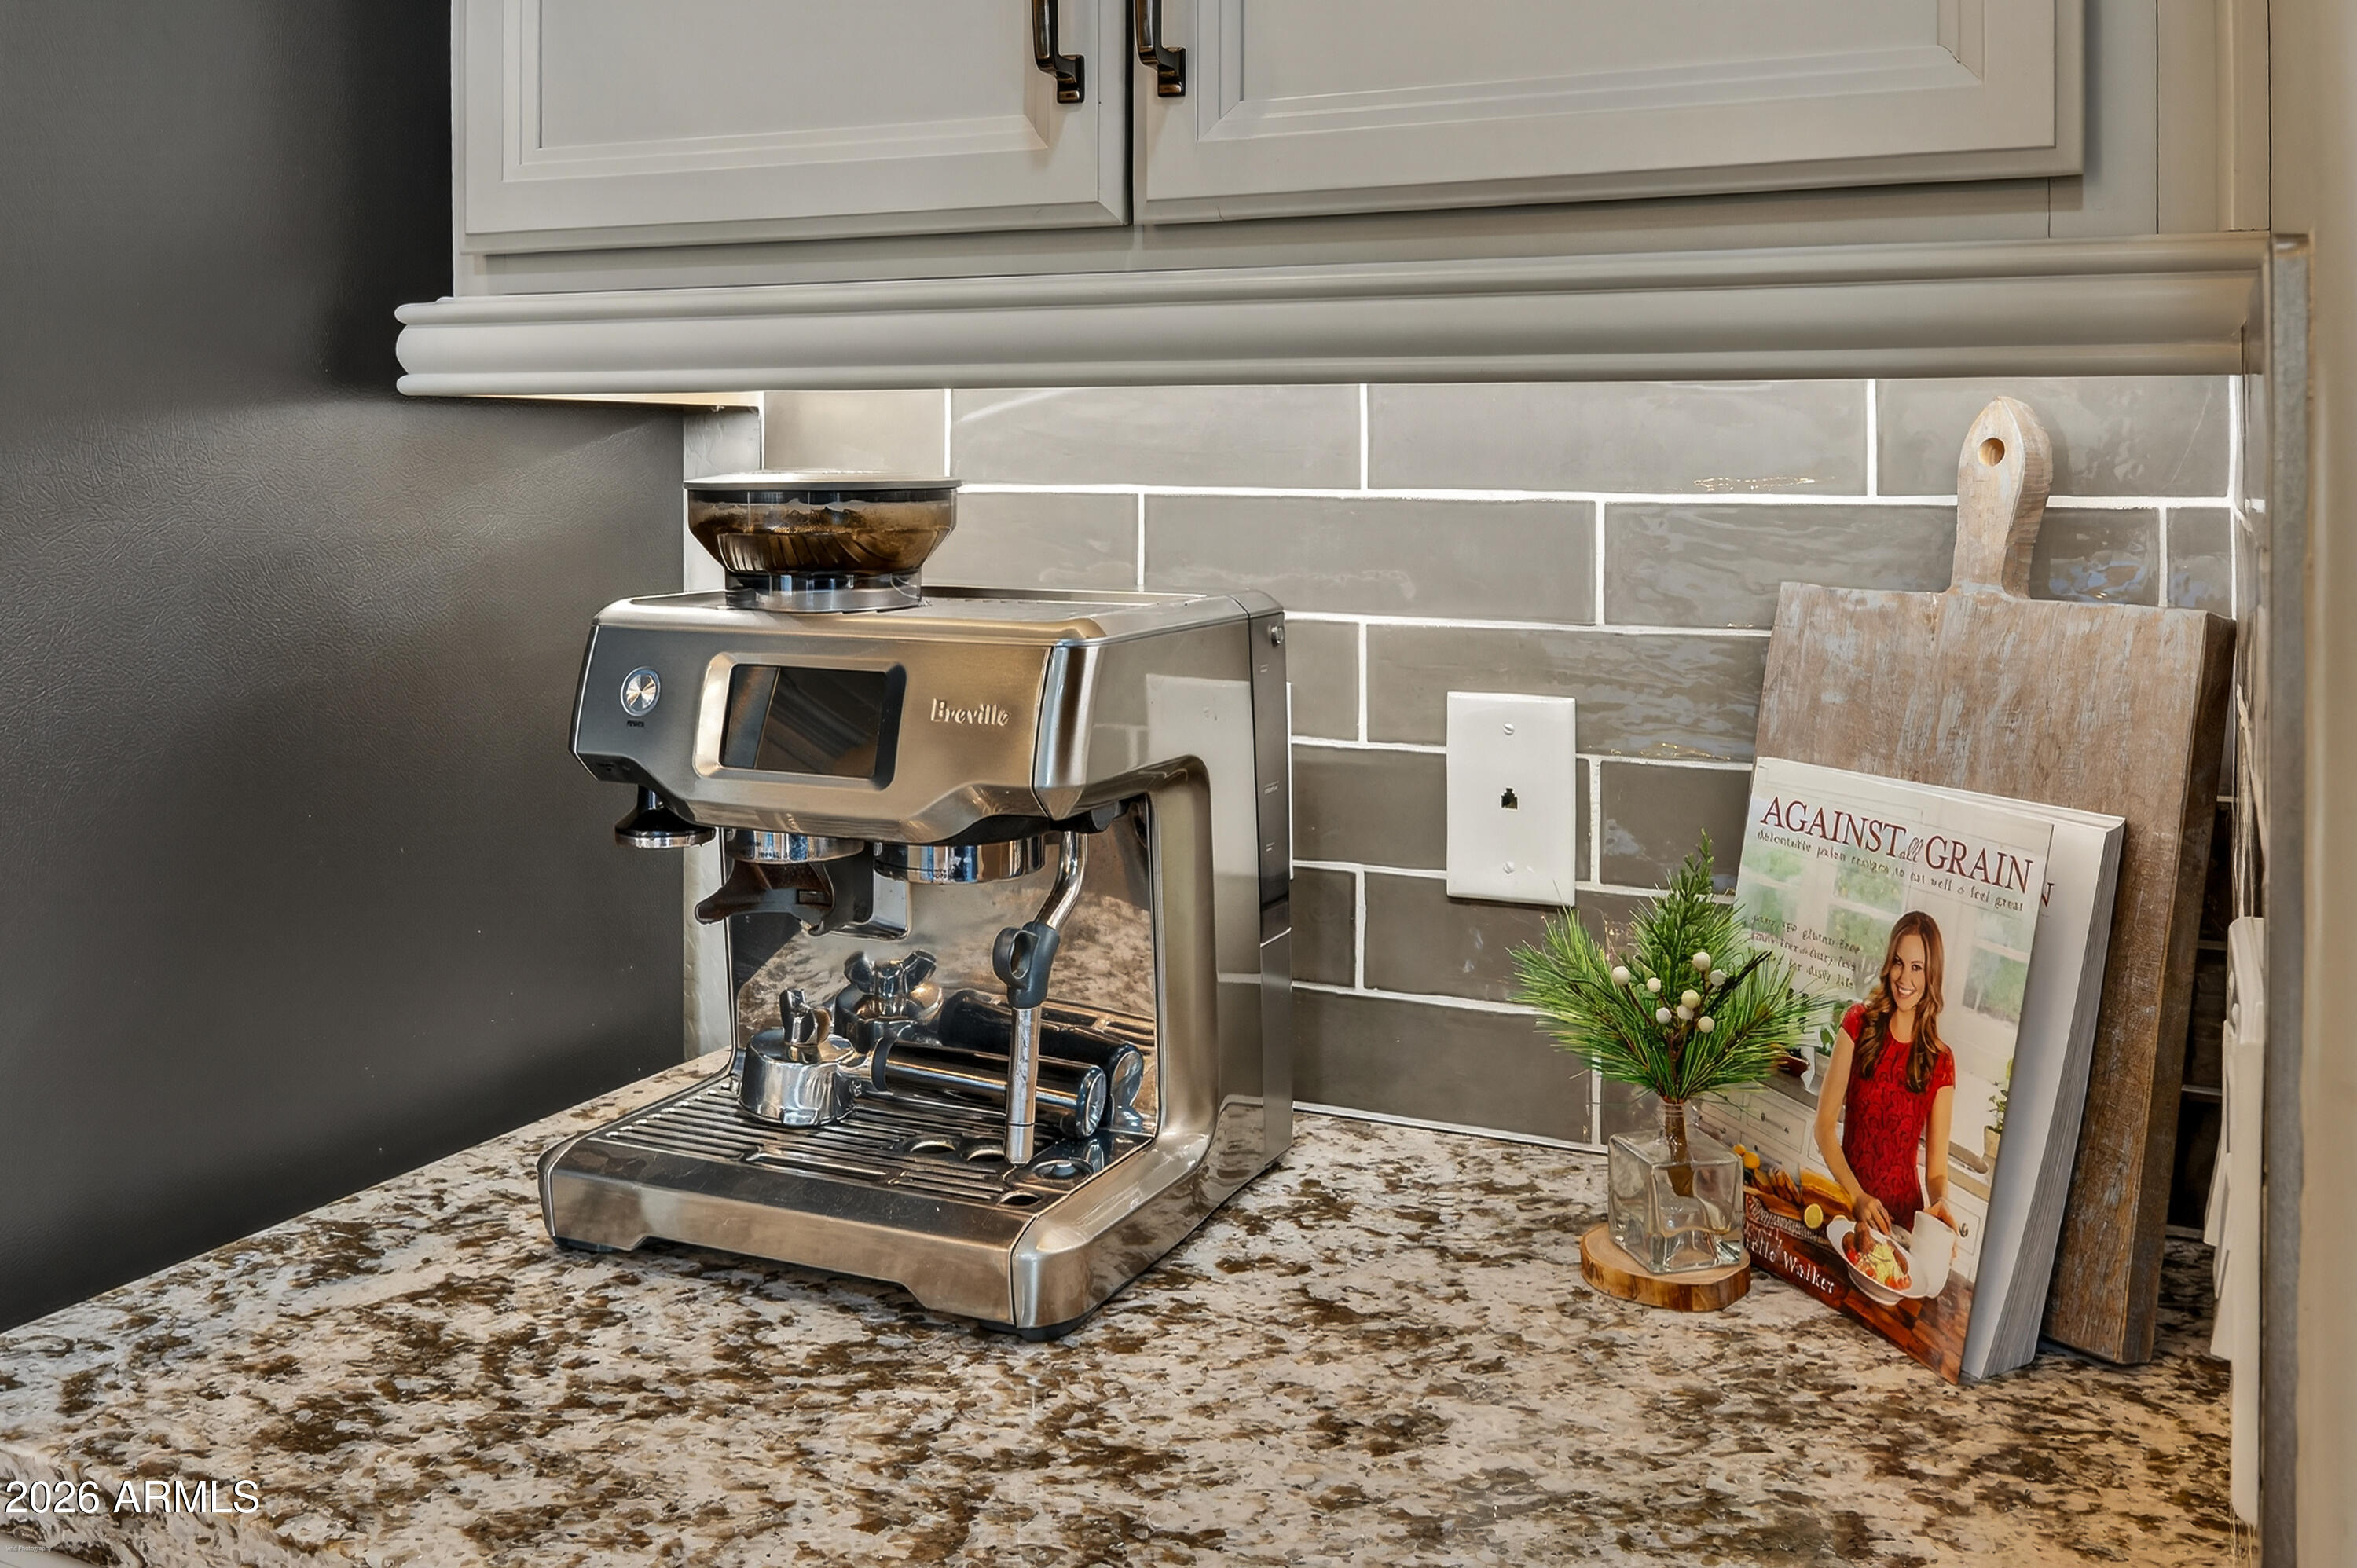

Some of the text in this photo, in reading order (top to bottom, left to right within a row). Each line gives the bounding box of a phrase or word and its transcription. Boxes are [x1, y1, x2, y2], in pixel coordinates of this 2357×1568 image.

[1760, 796, 2034, 894] AGAINST all GRAIN
[1930, 877, 1953, 892] well
[1970, 885, 1991, 903] feel
[1995, 896, 2024, 913] great
[1783, 1250, 1835, 1295] Walker
